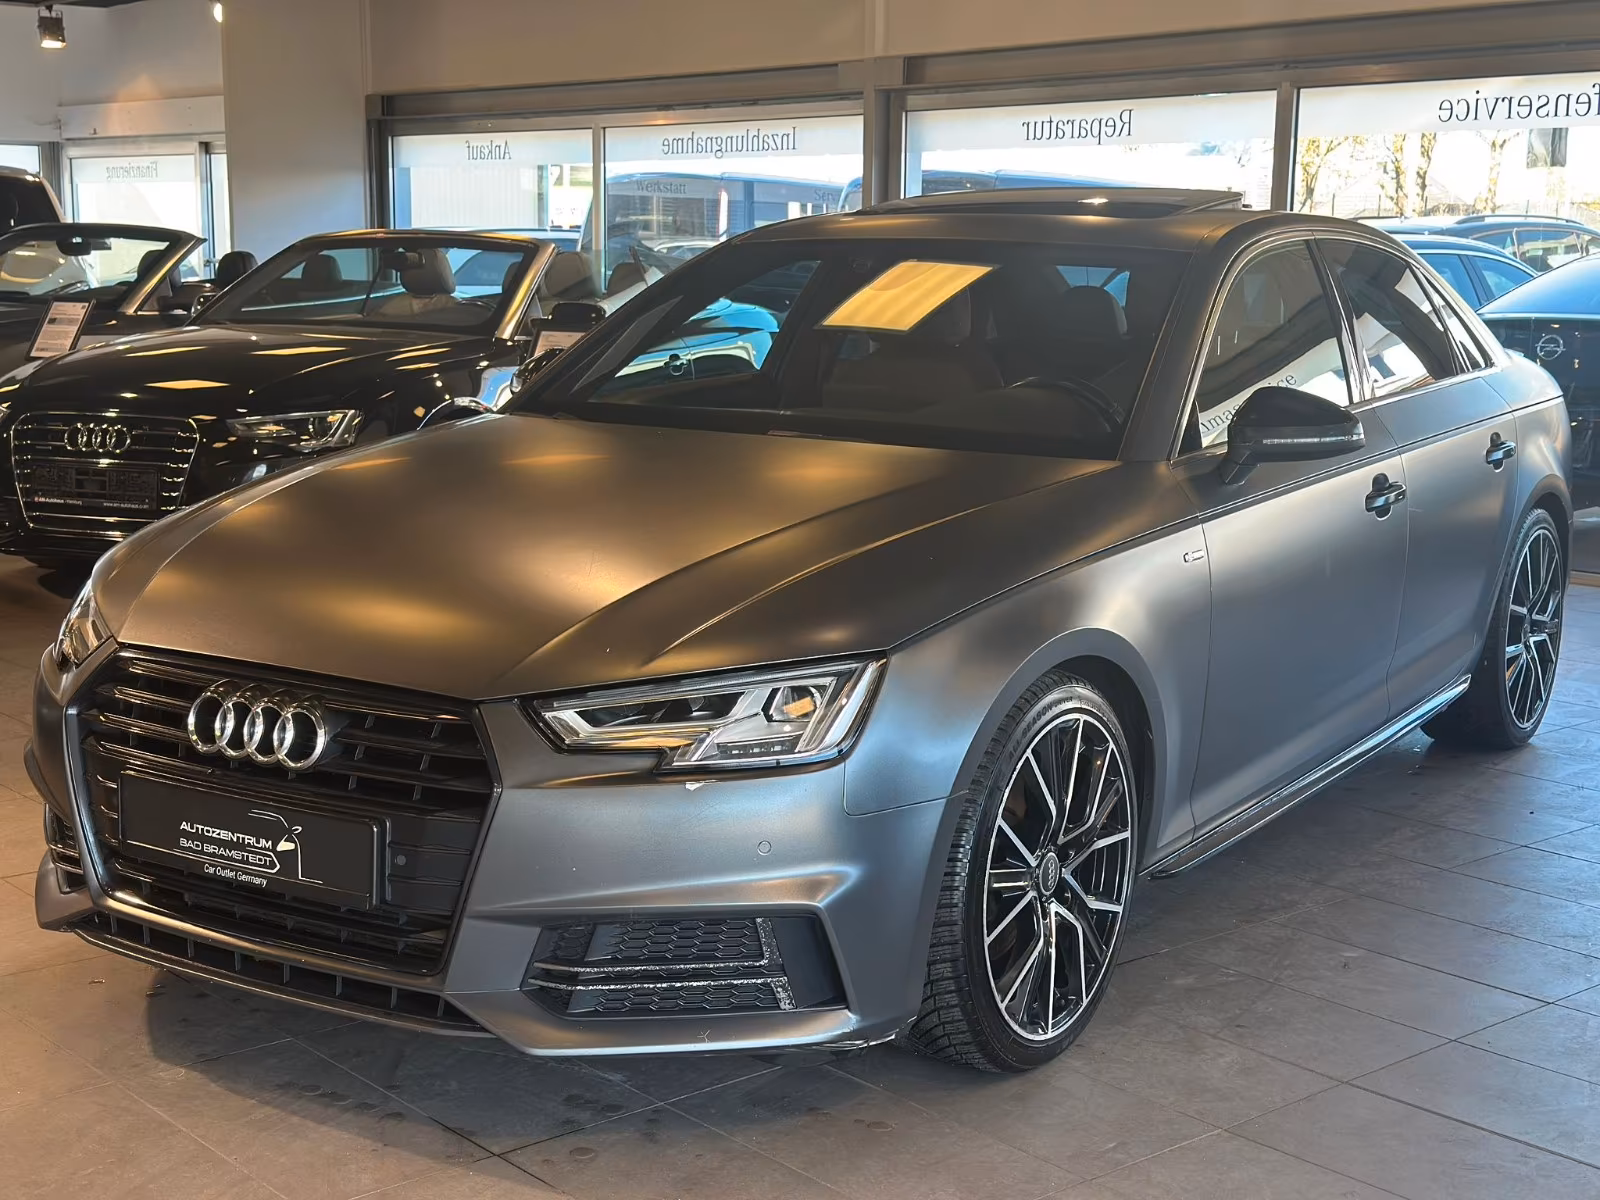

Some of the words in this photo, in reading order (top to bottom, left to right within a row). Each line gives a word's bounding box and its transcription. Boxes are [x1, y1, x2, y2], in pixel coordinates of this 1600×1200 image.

[636, 180, 687, 194] Werkstatt
[180, 821, 273, 850] AUTOZENTRUM
[180, 838, 202, 851] BAD
[204, 843, 273, 866] BRAMSTEDT
[204, 863, 215, 874] Car
[216, 866, 236, 880] Outlet
[237, 871, 268, 887] Germany
